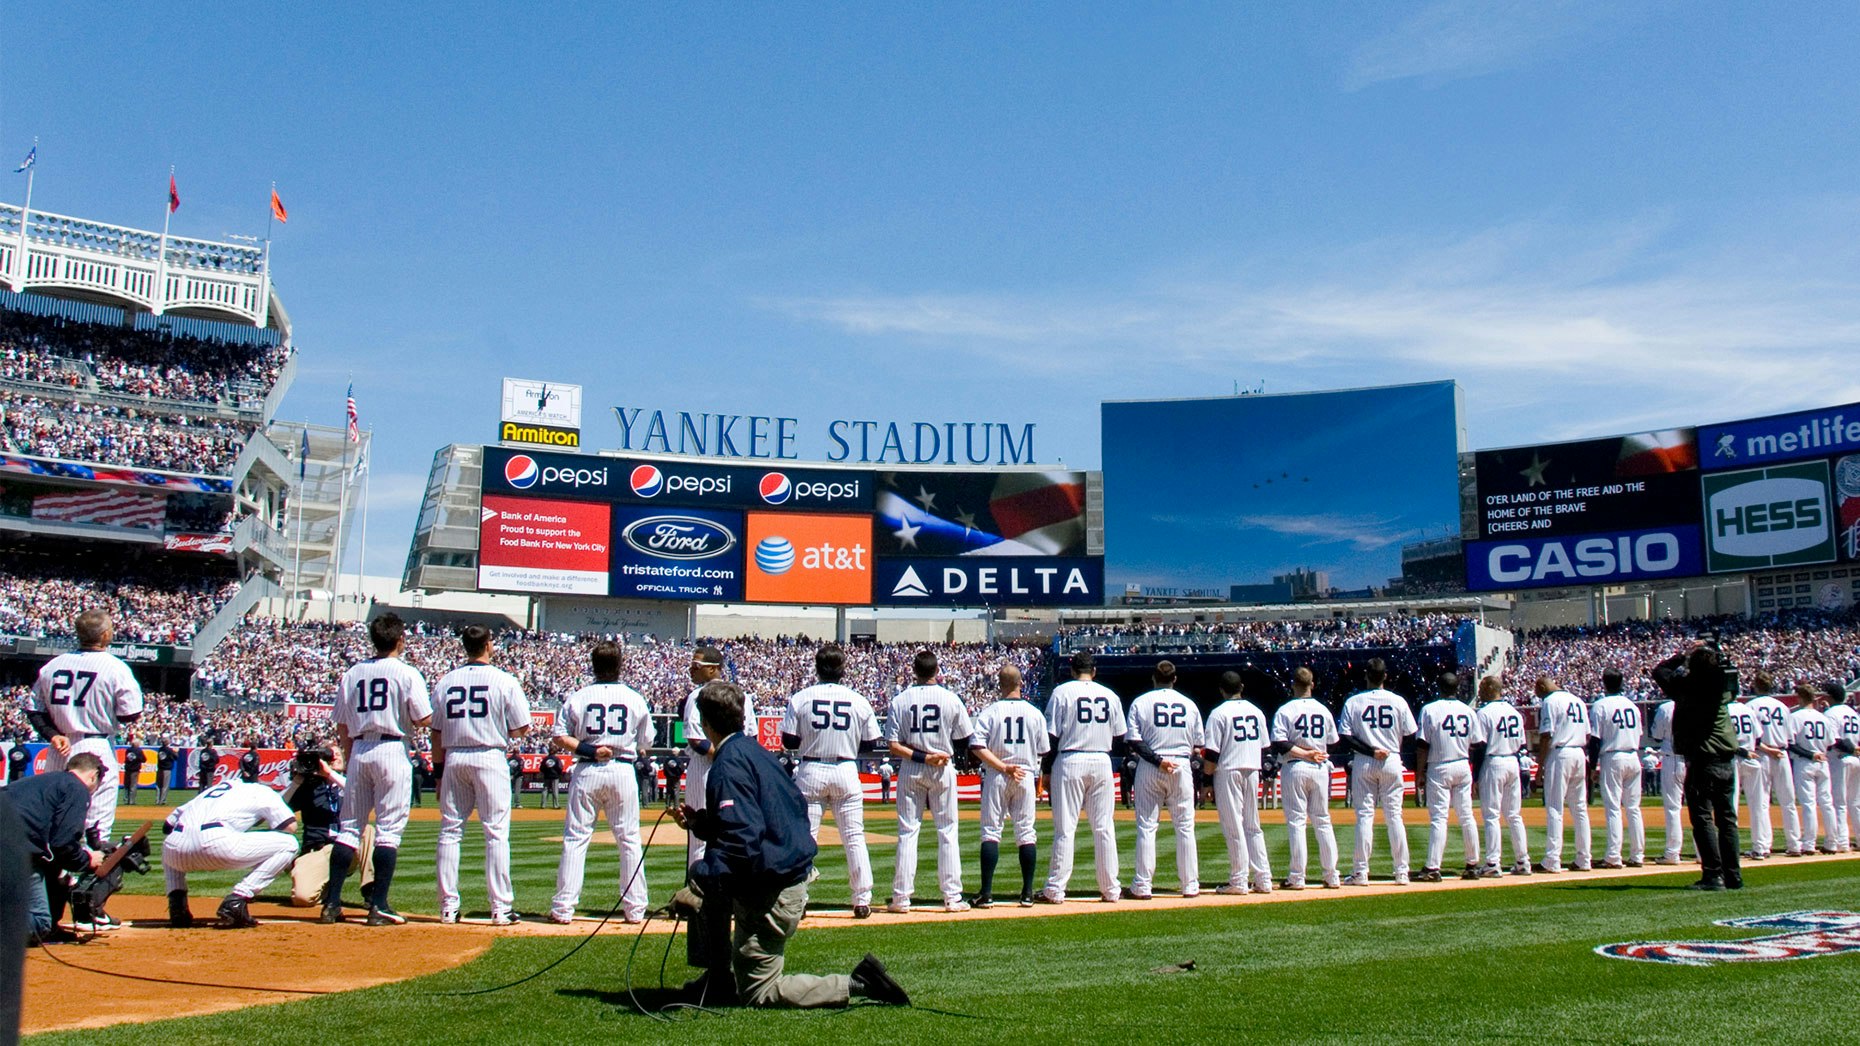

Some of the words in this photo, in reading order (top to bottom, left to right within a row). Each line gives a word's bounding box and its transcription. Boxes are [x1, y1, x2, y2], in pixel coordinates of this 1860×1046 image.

[526, 389, 560, 400] Armon
[503, 423, 578, 447] Armitron
[611, 407, 798, 460] YANKEE
[827, 420, 1036, 465] STADIUM
[542, 467, 608, 487] pepsi
[666, 475, 731, 496] pepsi
[795, 480, 859, 502] pepsi
[1487, 495, 1509, 505] O'ER
[1511, 492, 1537, 503] LAND
[1538, 491, 1552, 501] OF
[1554, 489, 1574, 499] THE
[1576, 486, 1600, 497] FREE
[1602, 484, 1623, 494] AND
[1625, 482, 1645, 492] THE
[501, 511, 522, 520] Bank
[533, 514, 567, 523] America
[1487, 508, 1516, 519] HOME
[1518, 507, 1532, 517] OF
[1533, 505, 1553, 515] THE
[1555, 502, 1587, 513] BRAVE
[1716, 497, 1822, 537] HESS
[500, 524, 524, 533] Proud
[526, 525, 534, 534] to
[536, 527, 566, 537] support
[568, 528, 581, 537] the
[648, 524, 709, 551] Ford
[1488, 520, 1529, 534] [CHEERS
[1531, 518, 1552, 529] AND
[500, 537, 519, 546] Food
[520, 538, 540, 547] Bank
[541, 540, 554, 548] For
[555, 542, 572, 550] New
[573, 543, 590, 551] York
[591, 544, 606, 553] City
[802, 543, 866, 570] at&t
[1488, 532, 1680, 582] CASIO
[502, 571, 527, 579] involved
[622, 564, 734, 579] tristateford.com
[943, 567, 1089, 594] DELTA
[636, 584, 676, 593] OFFICIAL
[678, 586, 708, 594] TRUCK
[1145, 587, 1179, 597] YANKEE
[128, 645, 158, 661] Spring
[51, 669, 98, 707] 27
[357, 678, 389, 713] 18
[446, 685, 489, 719] 25
[1077, 696, 1110, 724] 63
[1566, 702, 1584, 723] 41
[586, 704, 628, 736] 33
[811, 699, 852, 731] 55
[910, 704, 941, 733] 12
[1153, 702, 1186, 727] 62
[1362, 705, 1394, 729] 46
[1442, 714, 1470, 738] 43
[1612, 708, 1636, 729] 40
[1759, 706, 1783, 726] 34
[1843, 715, 1859, 734] 26
[1004, 716, 1026, 744] 11
[1233, 715, 1260, 742] 53
[1294, 714, 1325, 739] 48
[1496, 715, 1519, 738] 42
[1804, 721, 1825, 740] 30
[204, 781, 232, 798] 2
